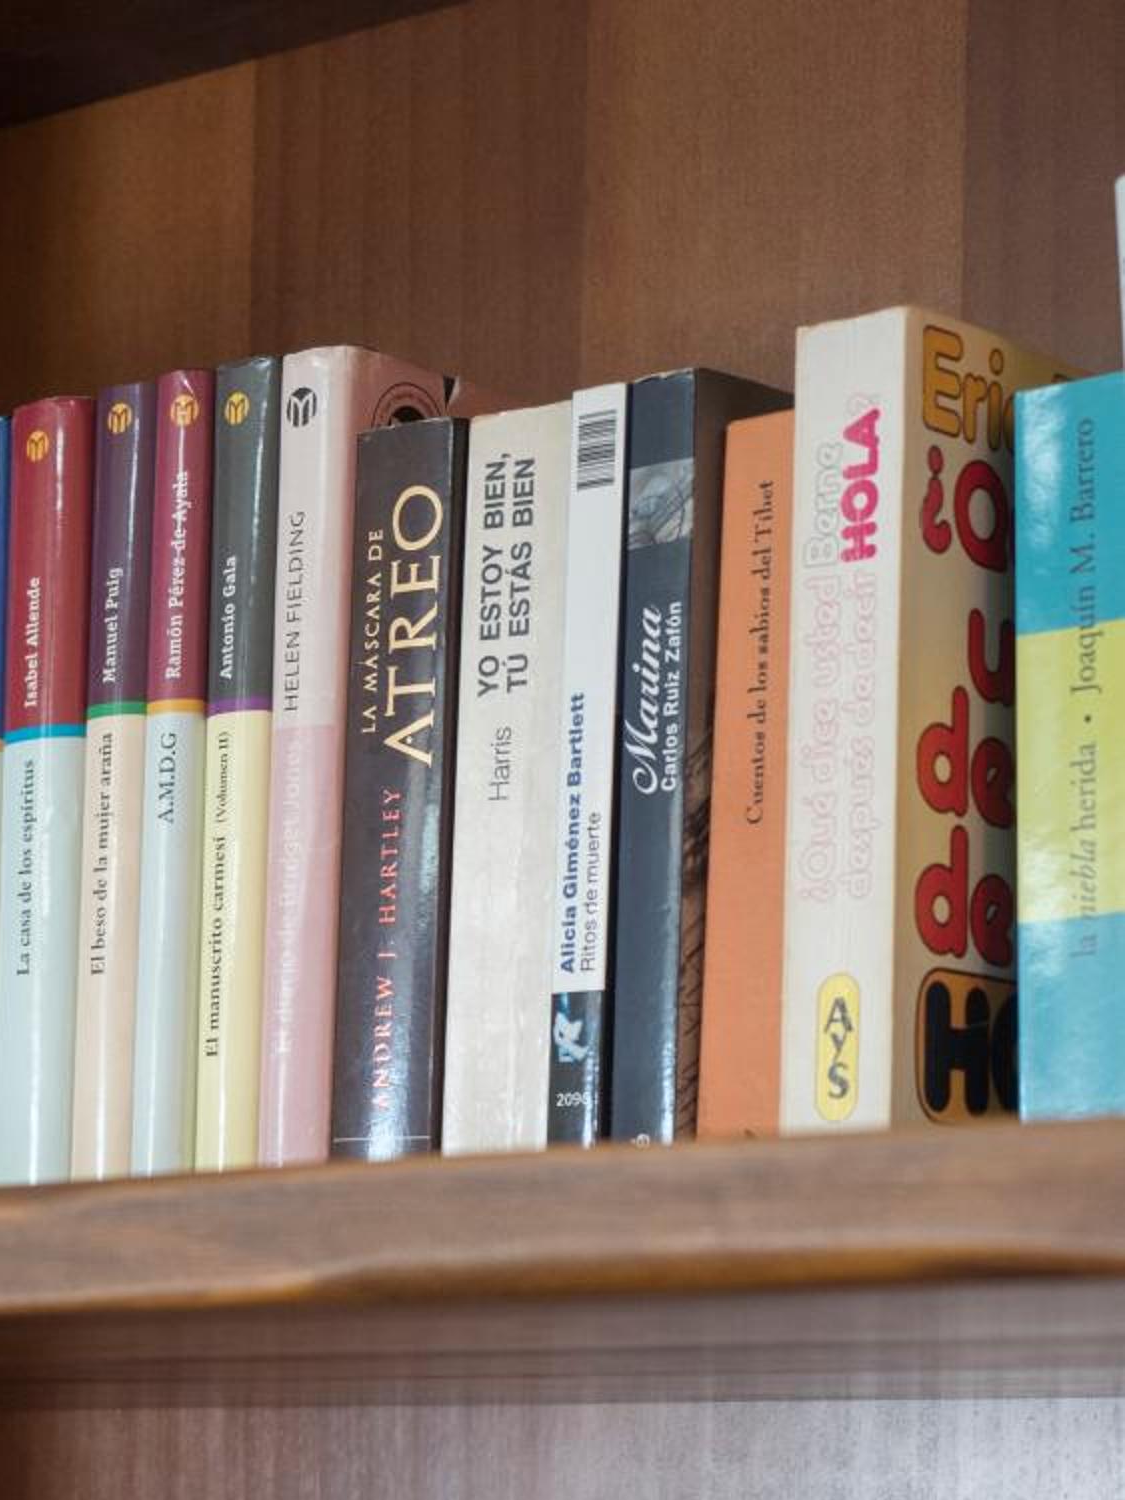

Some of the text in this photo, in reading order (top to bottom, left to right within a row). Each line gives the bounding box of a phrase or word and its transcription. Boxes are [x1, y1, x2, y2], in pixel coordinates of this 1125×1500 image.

[165, 470, 192, 680] Ramón Pérez de Ayala
[477, 453, 509, 698] YO ESTOY BIEN,
[502, 458, 535, 693] TÚ ESTÁS BIEN
[802, 441, 841, 568] Berne
[24, 577, 40, 707] Isabel Allende
[103, 568, 123, 683] Manuel Puig
[219, 555, 237, 680] Antonio Gala
[284, 511, 305, 711] HELEN FIELDING
[358, 529, 383, 733] LA MÁSCARA DE
[383, 485, 443, 768] ATREO
[661, 601, 683, 791] Carlos Ruiz Zafón
[747, 480, 775, 824] Cuentos de los sabios del Tibet
[803, 576, 839, 688] usted
[1069, 419, 1103, 959] la niebla herida Joaquín M. Barrero
[158, 732, 176, 824] A.M.D.G
[488, 726, 512, 800] Harris
[625, 604, 662, 795] Marina
[16, 760, 37, 976] La casa de los espíritus
[91, 733, 114, 975] El beso de la mujer araña
[216, 753, 229, 823] (Volumen
[379, 786, 402, 925] HARTLEY
[560, 693, 584, 974] Alicia Giménez Bartlett
[207, 917, 223, 1030] manuscrito
[580, 812, 601, 971] Ritos de muerte
[205, 1037, 218, 1058] El
[372, 975, 394, 1109] ANDREW
